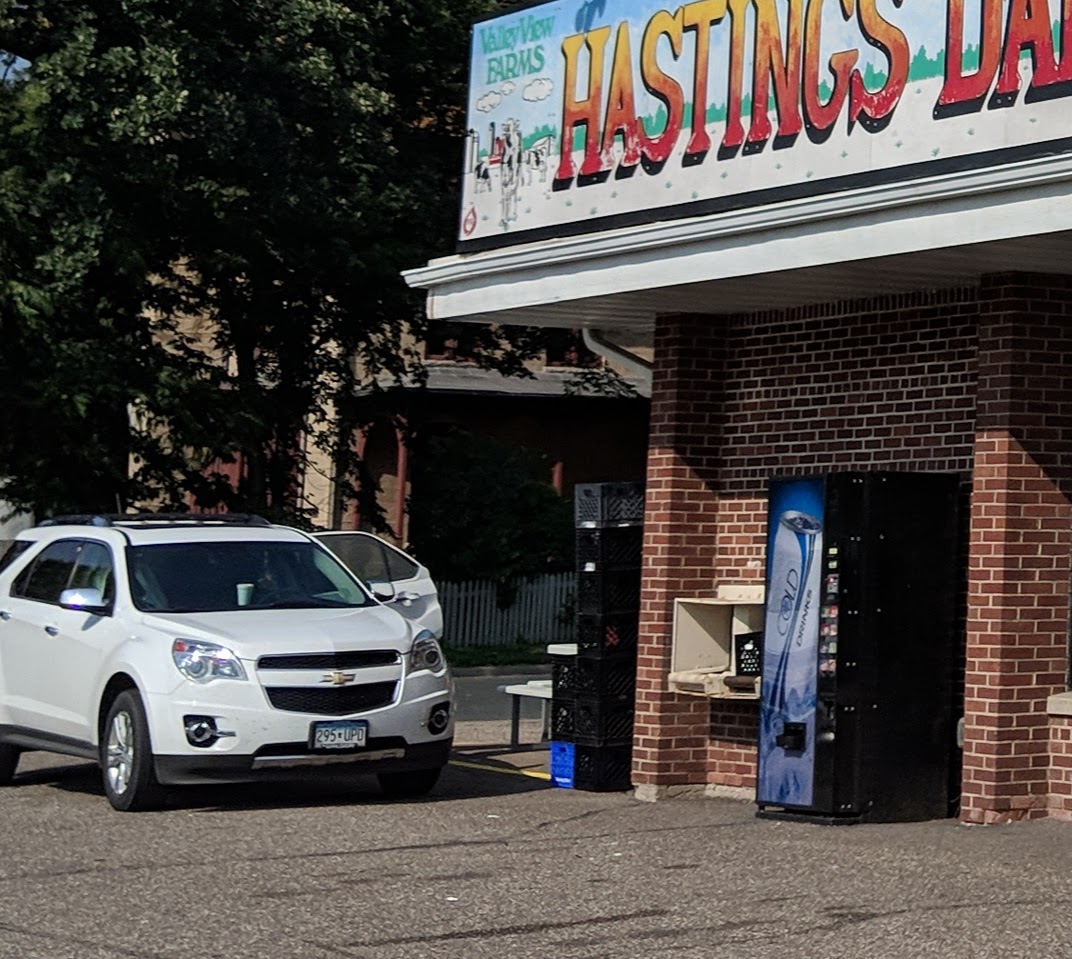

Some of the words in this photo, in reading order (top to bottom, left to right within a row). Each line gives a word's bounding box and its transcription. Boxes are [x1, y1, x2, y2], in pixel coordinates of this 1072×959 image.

[486, 45, 545, 85] FARMS
[777, 568, 799, 637] COLD
[796, 589, 813, 648] DRINKS
[317, 728, 337, 743] 295
